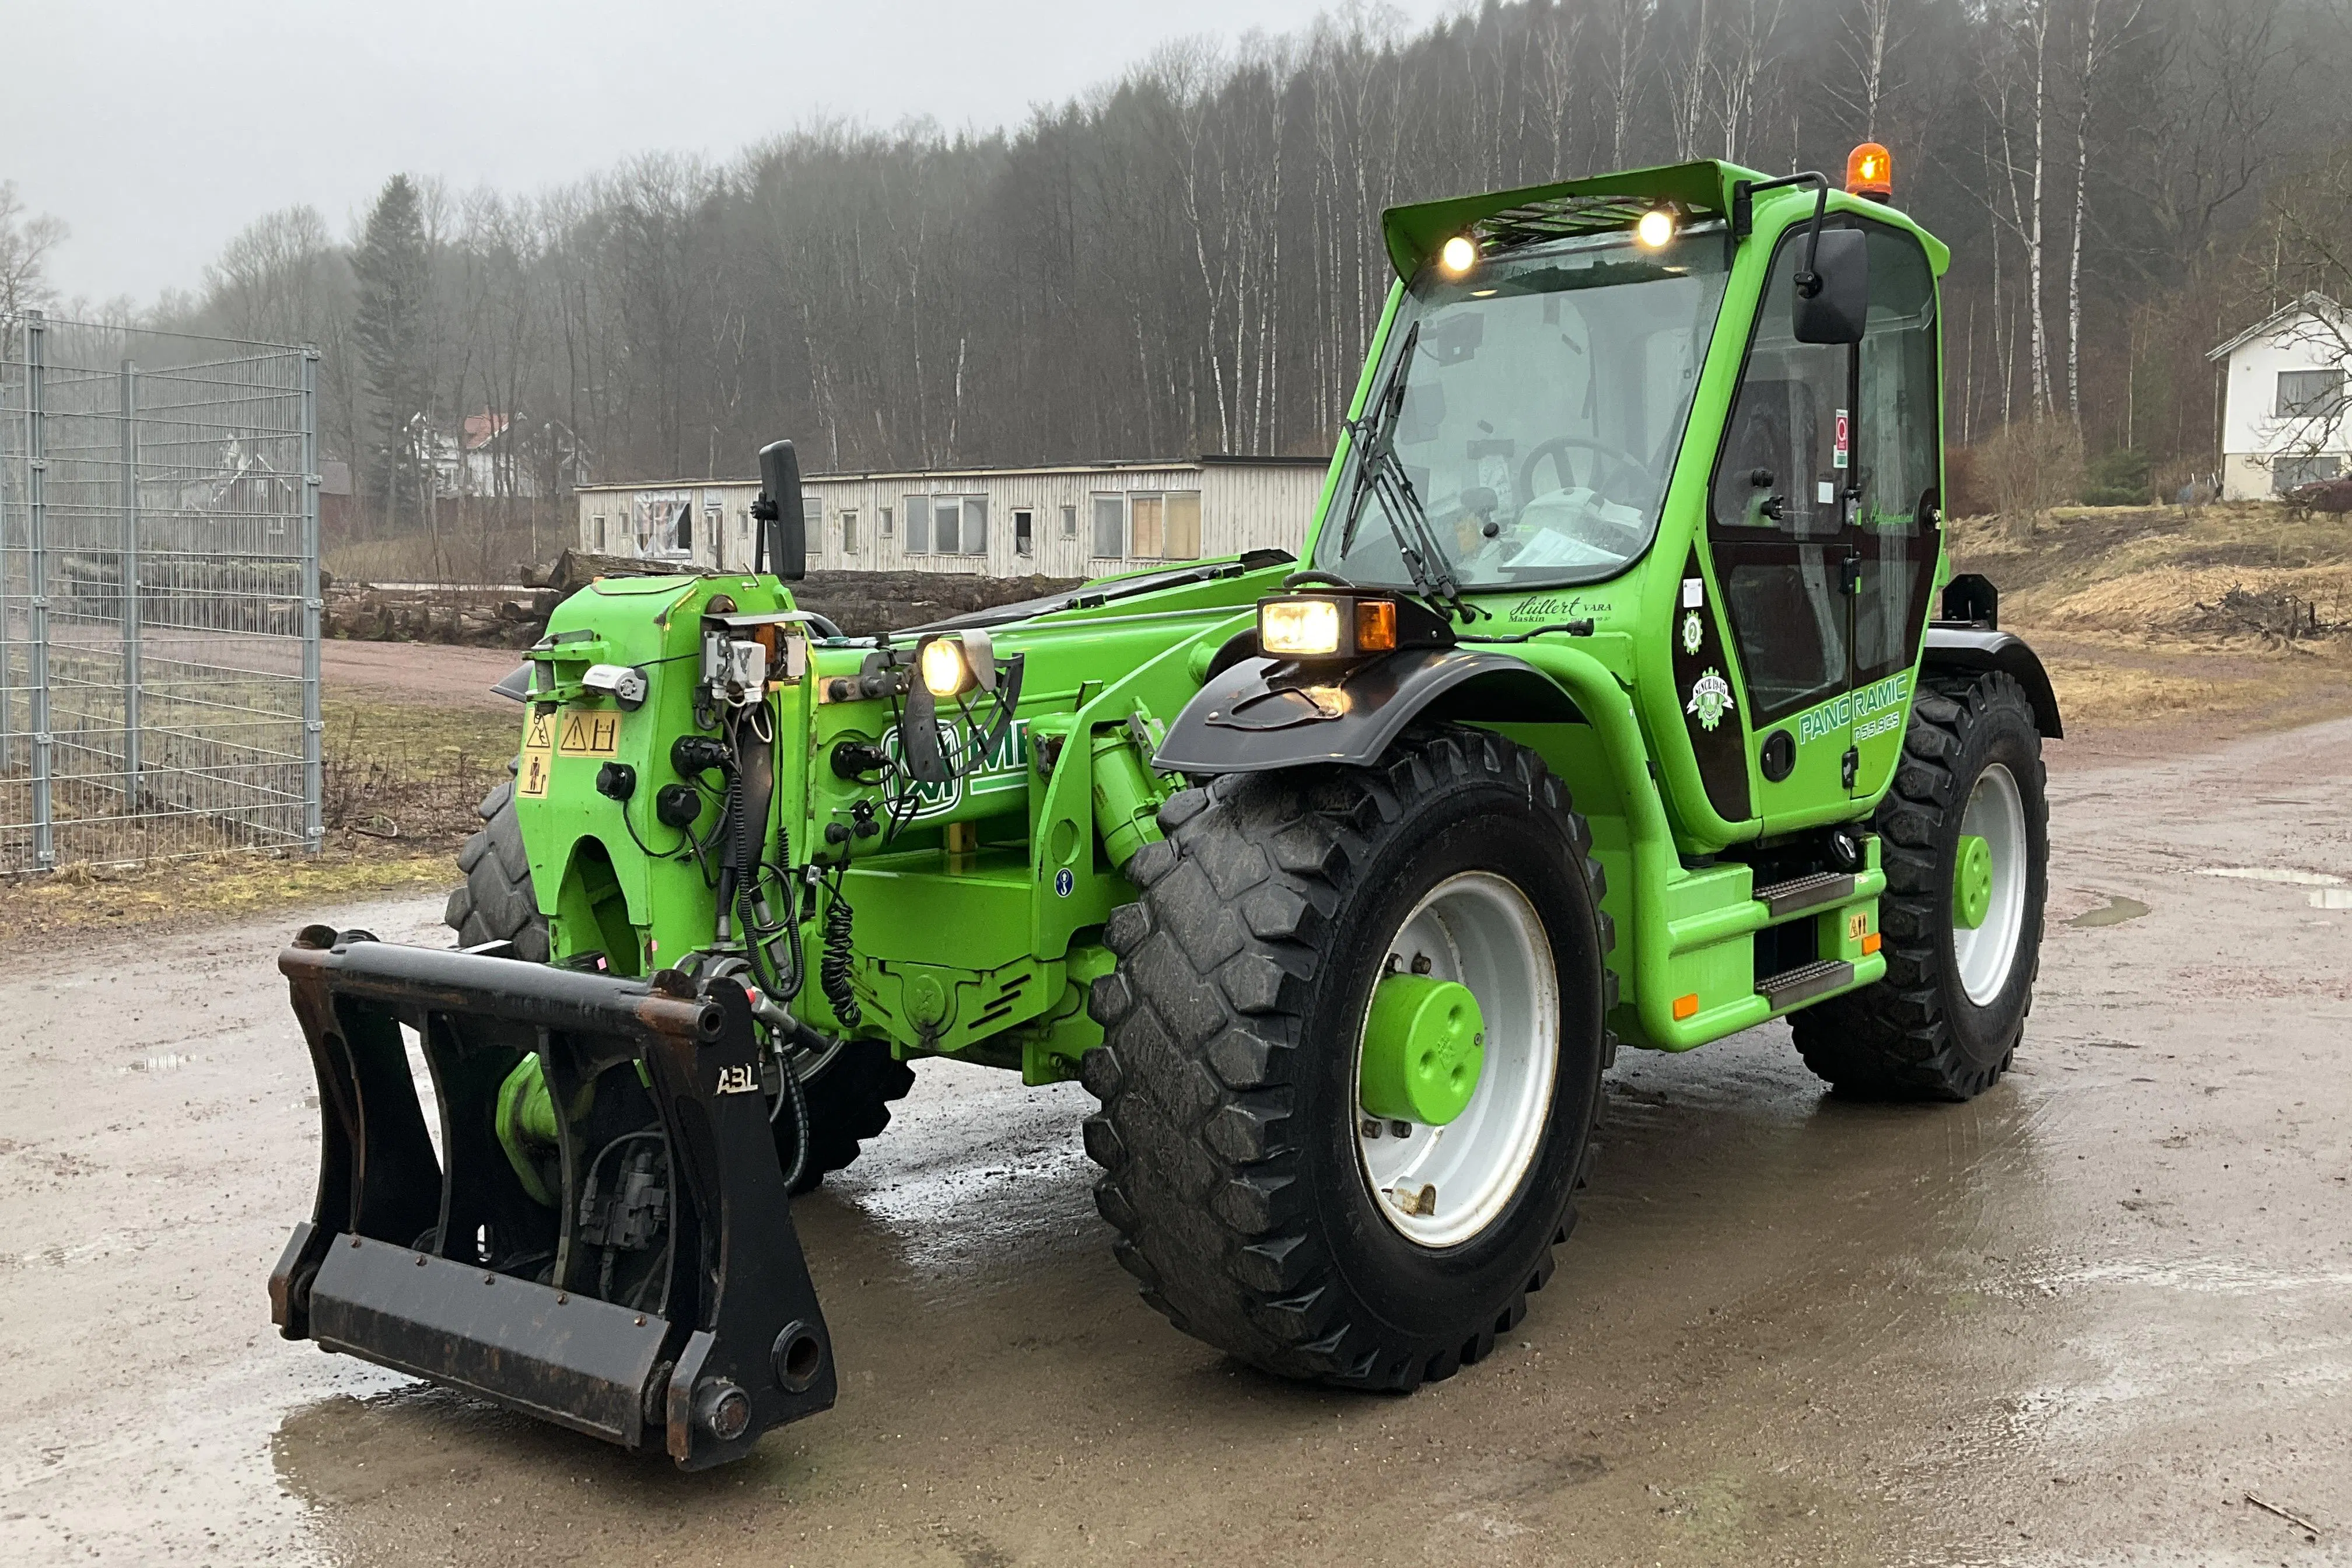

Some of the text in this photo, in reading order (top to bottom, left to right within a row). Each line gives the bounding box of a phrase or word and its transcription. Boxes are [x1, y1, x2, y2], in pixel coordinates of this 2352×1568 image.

[1510, 596, 1581, 616] Hüllert
[1690, 625, 1695, 639] 2
[1695, 678, 1726, 696] SINCE 1945
[1705, 694, 1716, 705] 70
[1799, 674, 1907, 745] PANORAMIC
[715, 1065, 758, 1095] ABL
